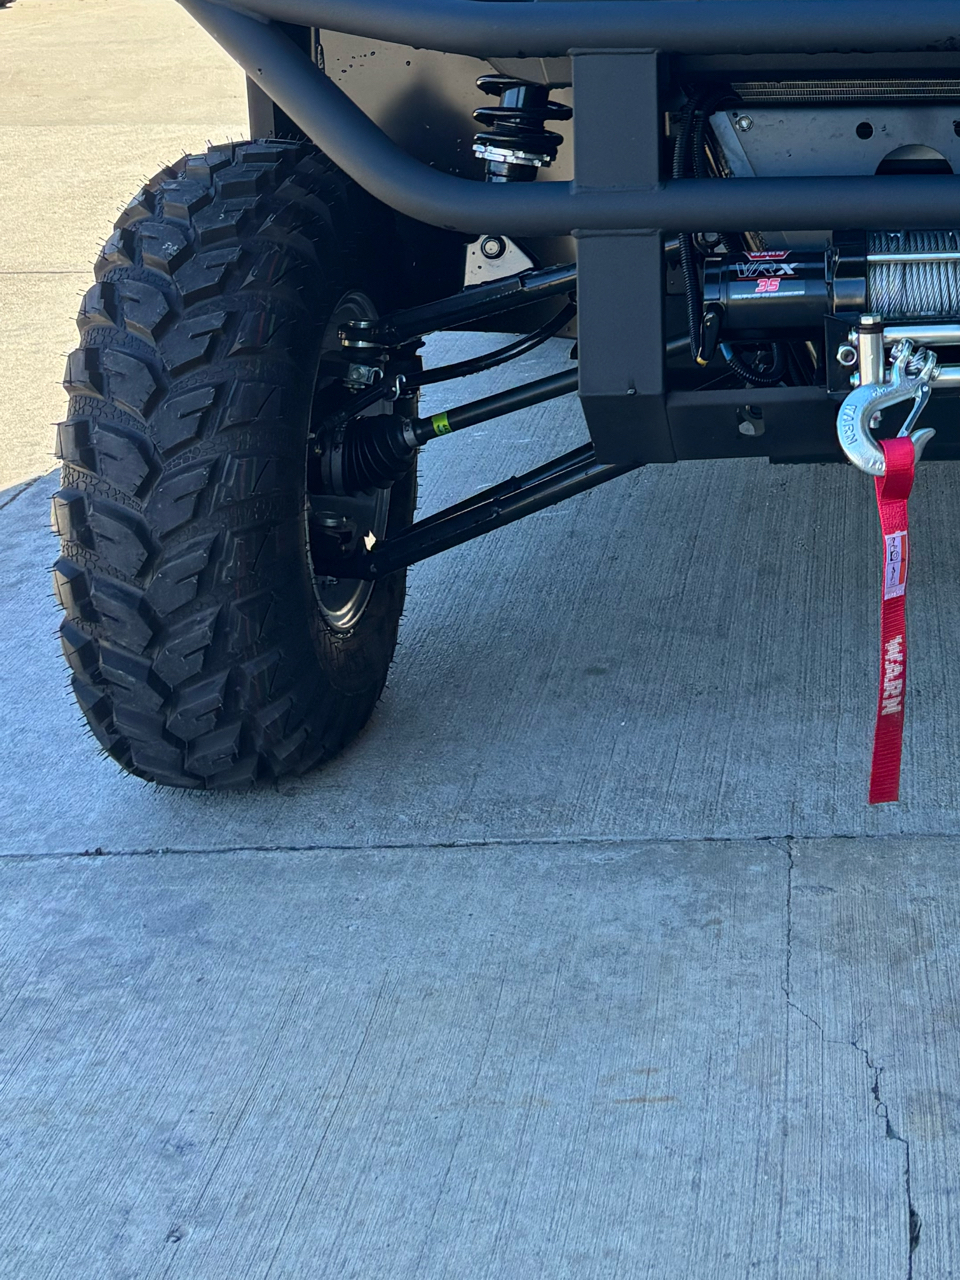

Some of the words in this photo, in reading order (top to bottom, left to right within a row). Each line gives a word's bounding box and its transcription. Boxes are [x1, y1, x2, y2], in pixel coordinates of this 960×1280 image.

[735, 261, 799, 277] VRX
[755, 278, 781, 293] 35
[842, 402, 859, 446] WARN
[881, 635, 903, 716] WARN
